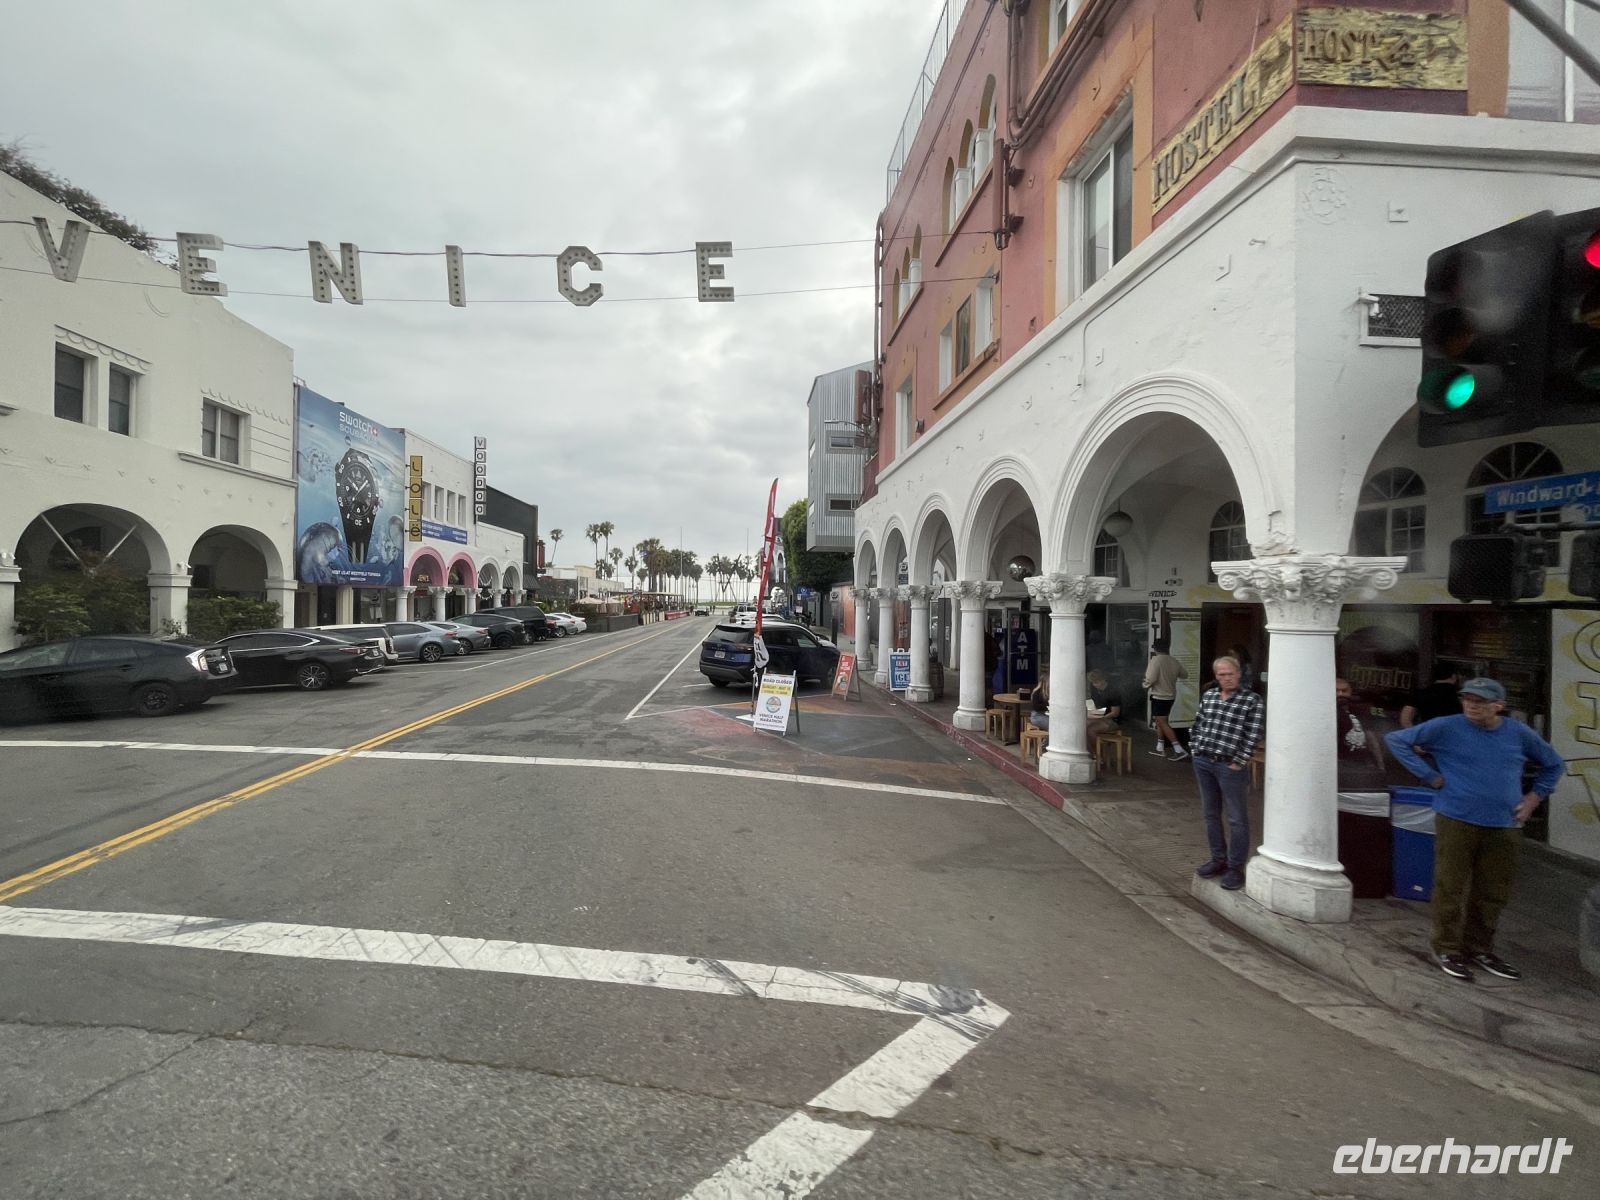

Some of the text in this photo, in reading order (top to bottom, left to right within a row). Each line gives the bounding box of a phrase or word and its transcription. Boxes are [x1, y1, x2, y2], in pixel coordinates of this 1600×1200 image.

[1152, 71, 1258, 197] HOSTEL
[32, 216, 735, 308] VENICE
[339, 411, 374, 433] swatch
[476, 440, 485, 513] VOODOO
[1497, 478, 1588, 507] Windward
[1016, 631, 1029, 671] ATM
